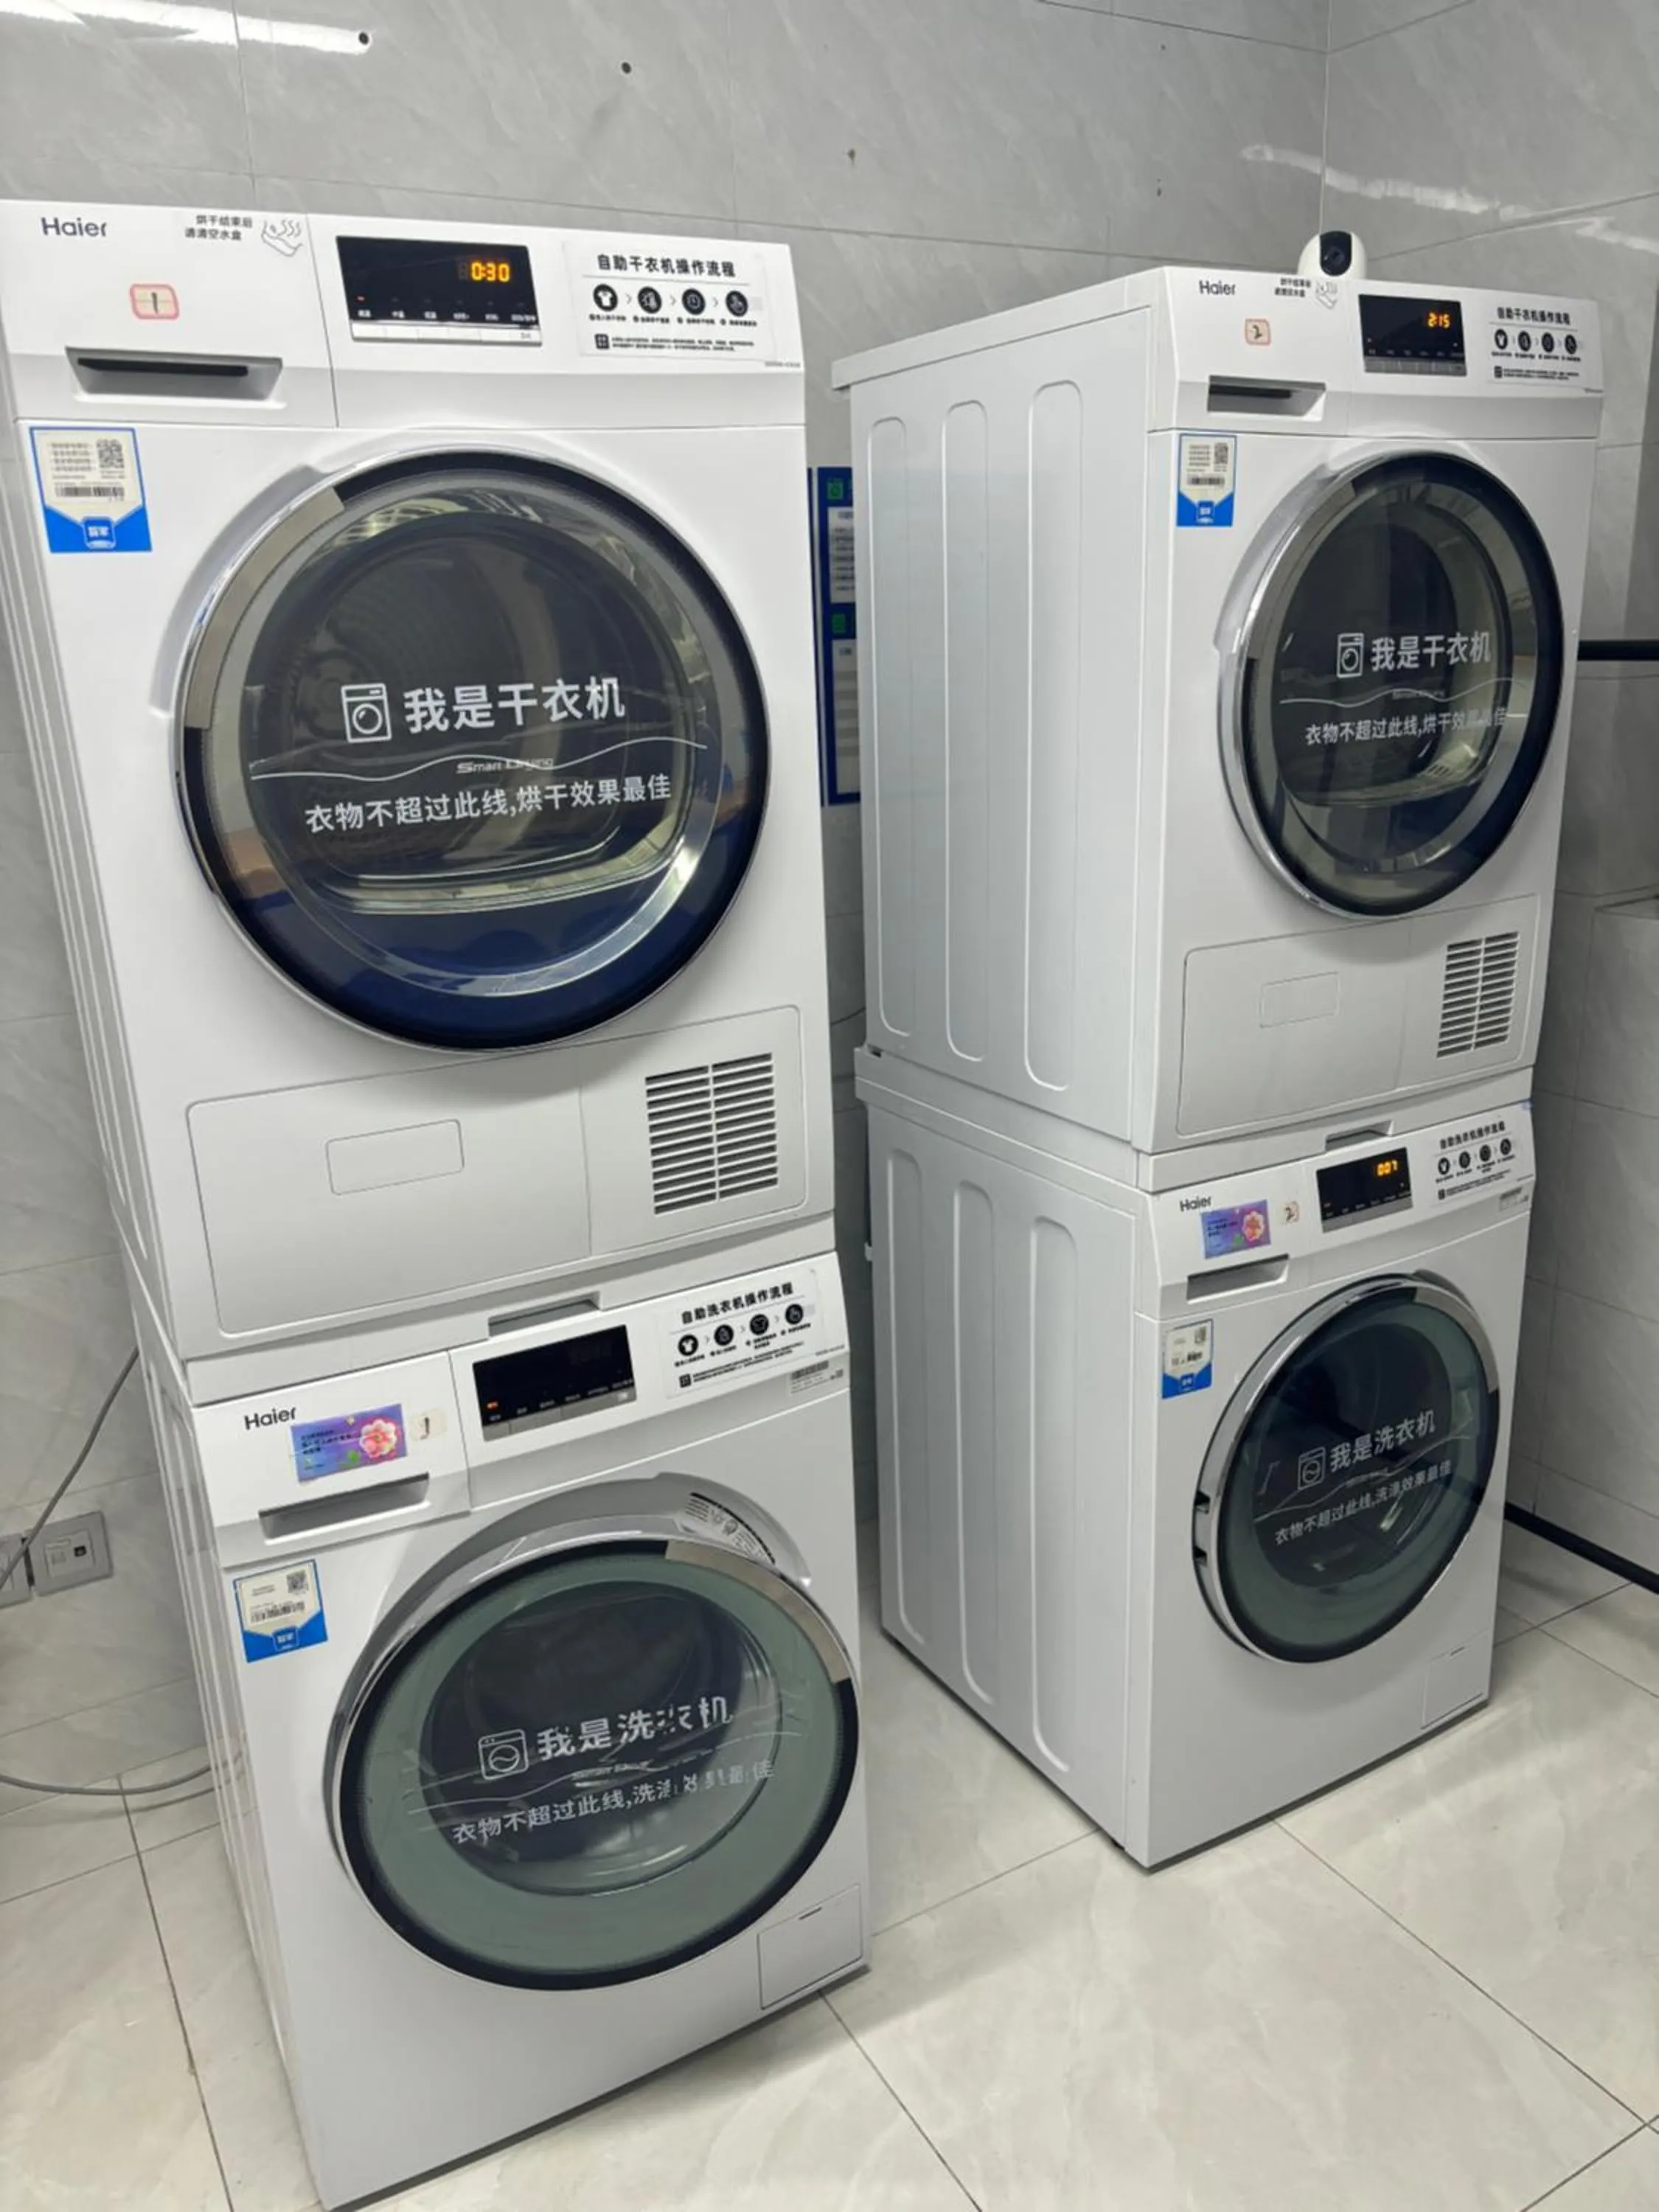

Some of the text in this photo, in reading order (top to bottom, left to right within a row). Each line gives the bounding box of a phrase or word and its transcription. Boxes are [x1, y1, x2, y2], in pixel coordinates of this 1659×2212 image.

[41, 218, 107, 237] Haier
[470, 260, 510, 283] 0:30
[597, 254, 736, 278] 自助干衣机操作流程
[1199, 279, 1236, 296] Haier
[1371, 631, 1491, 672] 我是干衣机
[403, 676, 626, 734] 我是干衣机
[1304, 706, 1507, 746] 衣物不超过此线,烘干效佳
[305, 774, 672, 835] 衣物不超过此线,烘干效果最佳
[1180, 1196, 1211, 1212] Haier
[681, 1281, 794, 1325] 自助洗衣机操作流程
[244, 1407, 296, 1430] Haier
[1329, 1409, 1436, 1473] 我是洗衣机
